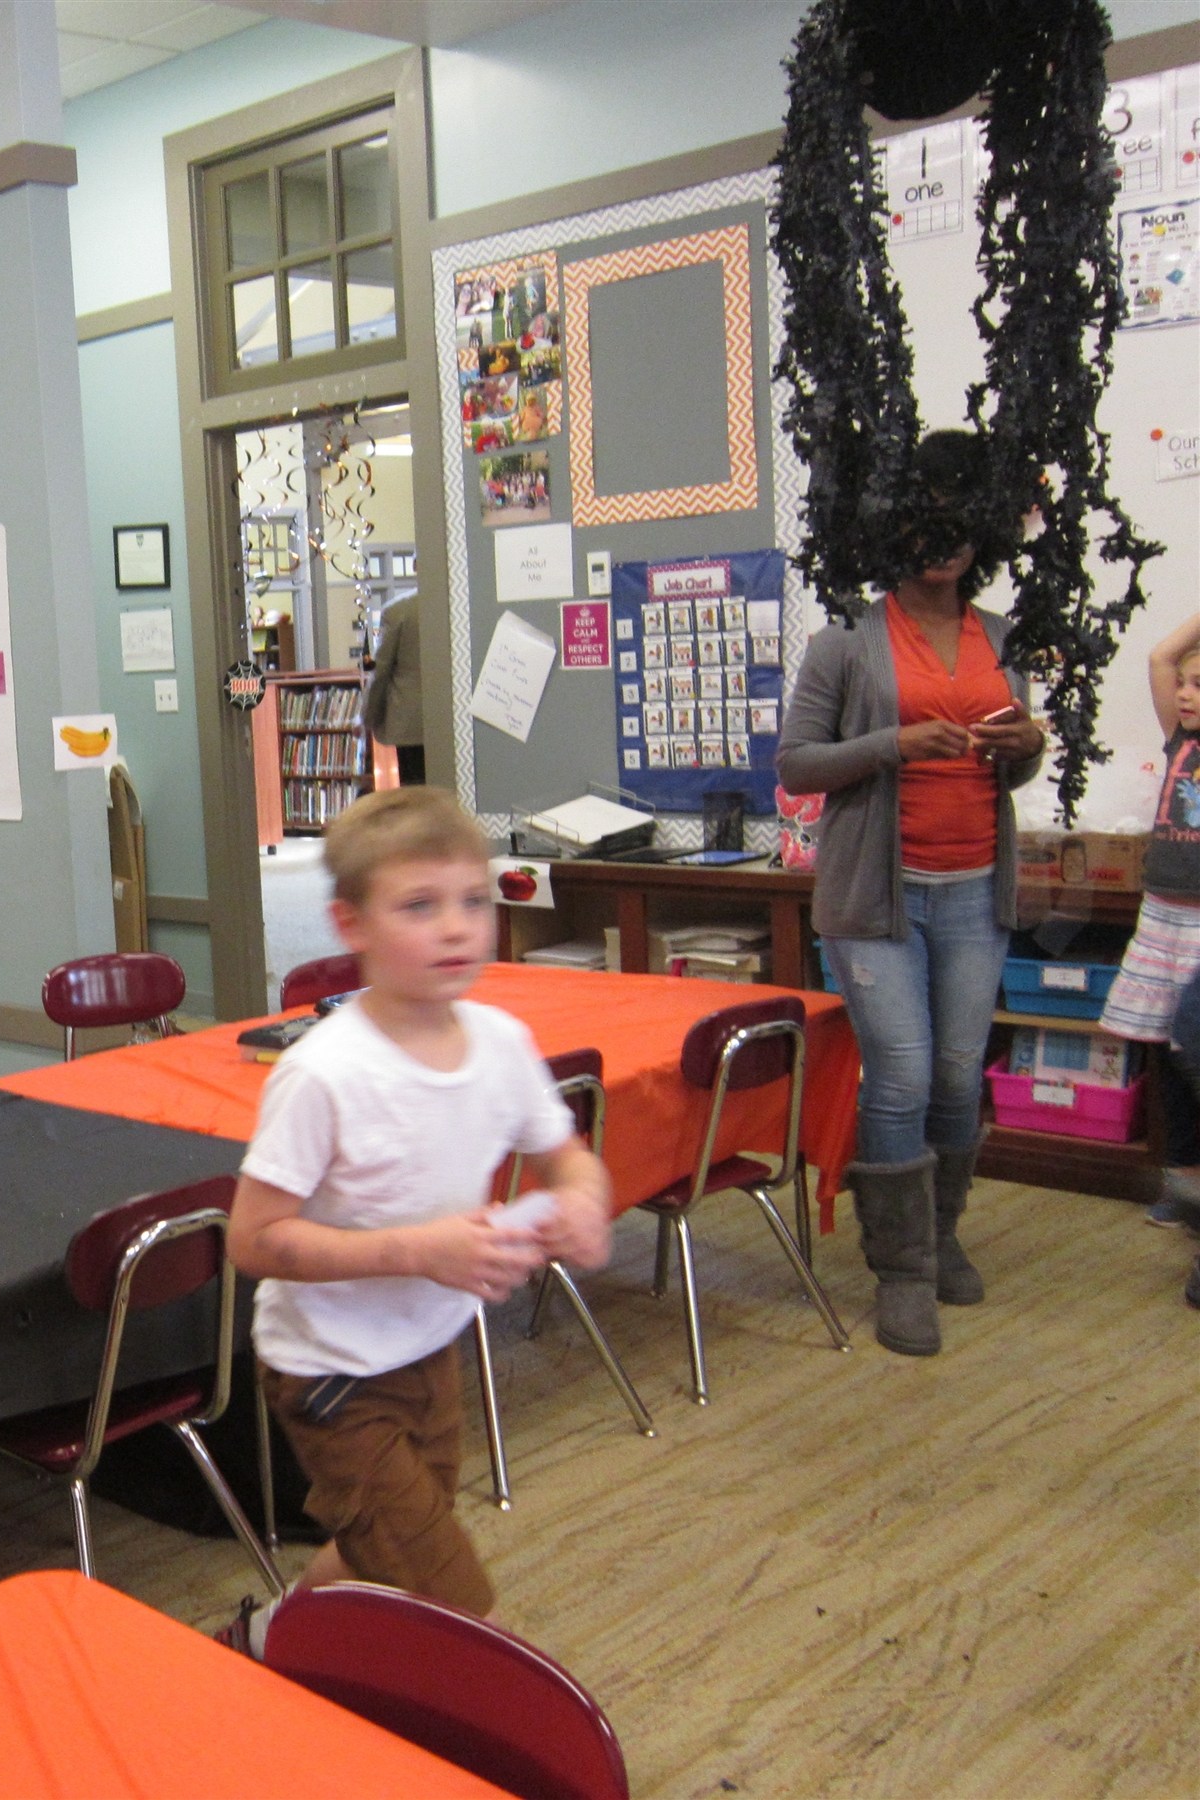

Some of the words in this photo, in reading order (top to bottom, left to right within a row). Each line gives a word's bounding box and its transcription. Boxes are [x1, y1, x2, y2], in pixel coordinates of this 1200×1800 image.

[904, 181, 944, 203] one
[1141, 211, 1186, 228] Noun
[527, 546, 538, 556] All
[520, 559, 547, 570] About
[528, 573, 542, 582] Me
[663, 578, 684, 593] Job
[685, 575, 713, 591] Chart
[574, 617, 596, 628] KEEP
[572, 628, 599, 639] CALM
[567, 643, 604, 655] RESPECT
[570, 654, 603, 665] OTHERS
[230, 676, 260, 695] BOO!
